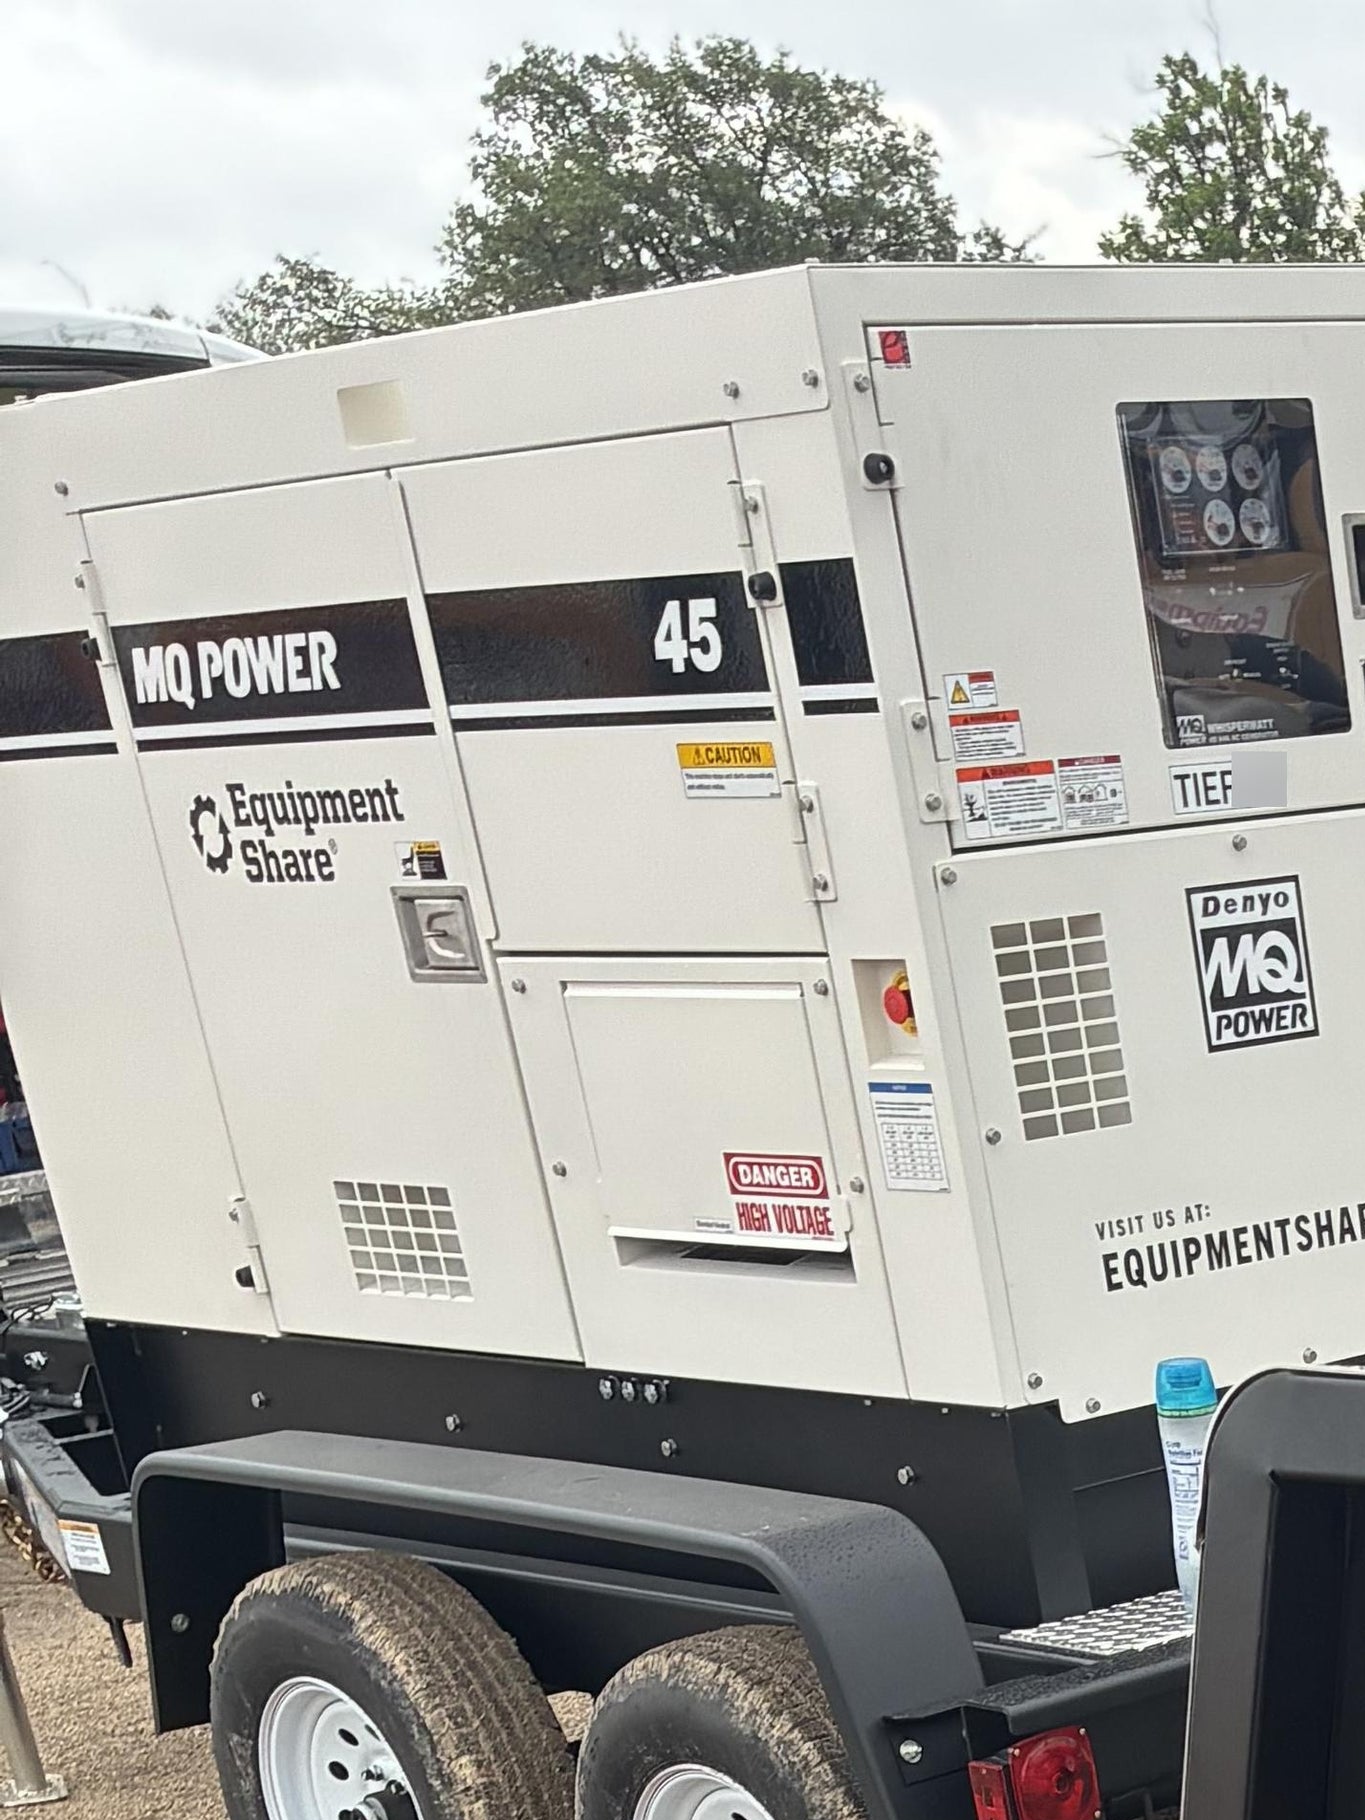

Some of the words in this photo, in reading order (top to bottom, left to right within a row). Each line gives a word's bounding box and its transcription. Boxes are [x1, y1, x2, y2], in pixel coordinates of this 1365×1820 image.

[653, 599, 723, 673] 45
[131, 646, 195, 712] MQ
[200, 630, 342, 700] POWER
[705, 746, 762, 763] CAUTION
[225, 779, 405, 837] Equipment
[1201, 889, 1290, 919] Denyo
[1203, 929, 1305, 997] MQ
[1213, 1005, 1309, 1042] POWER
[738, 1164, 814, 1188] DANGER
[736, 1202, 772, 1233] HIGH
[772, 1204, 834, 1236] VOLTAGE
[1095, 1212, 1145, 1242] VISIT
[1152, 1206, 1176, 1230] US
[1184, 1203, 1212, 1225] AT:
